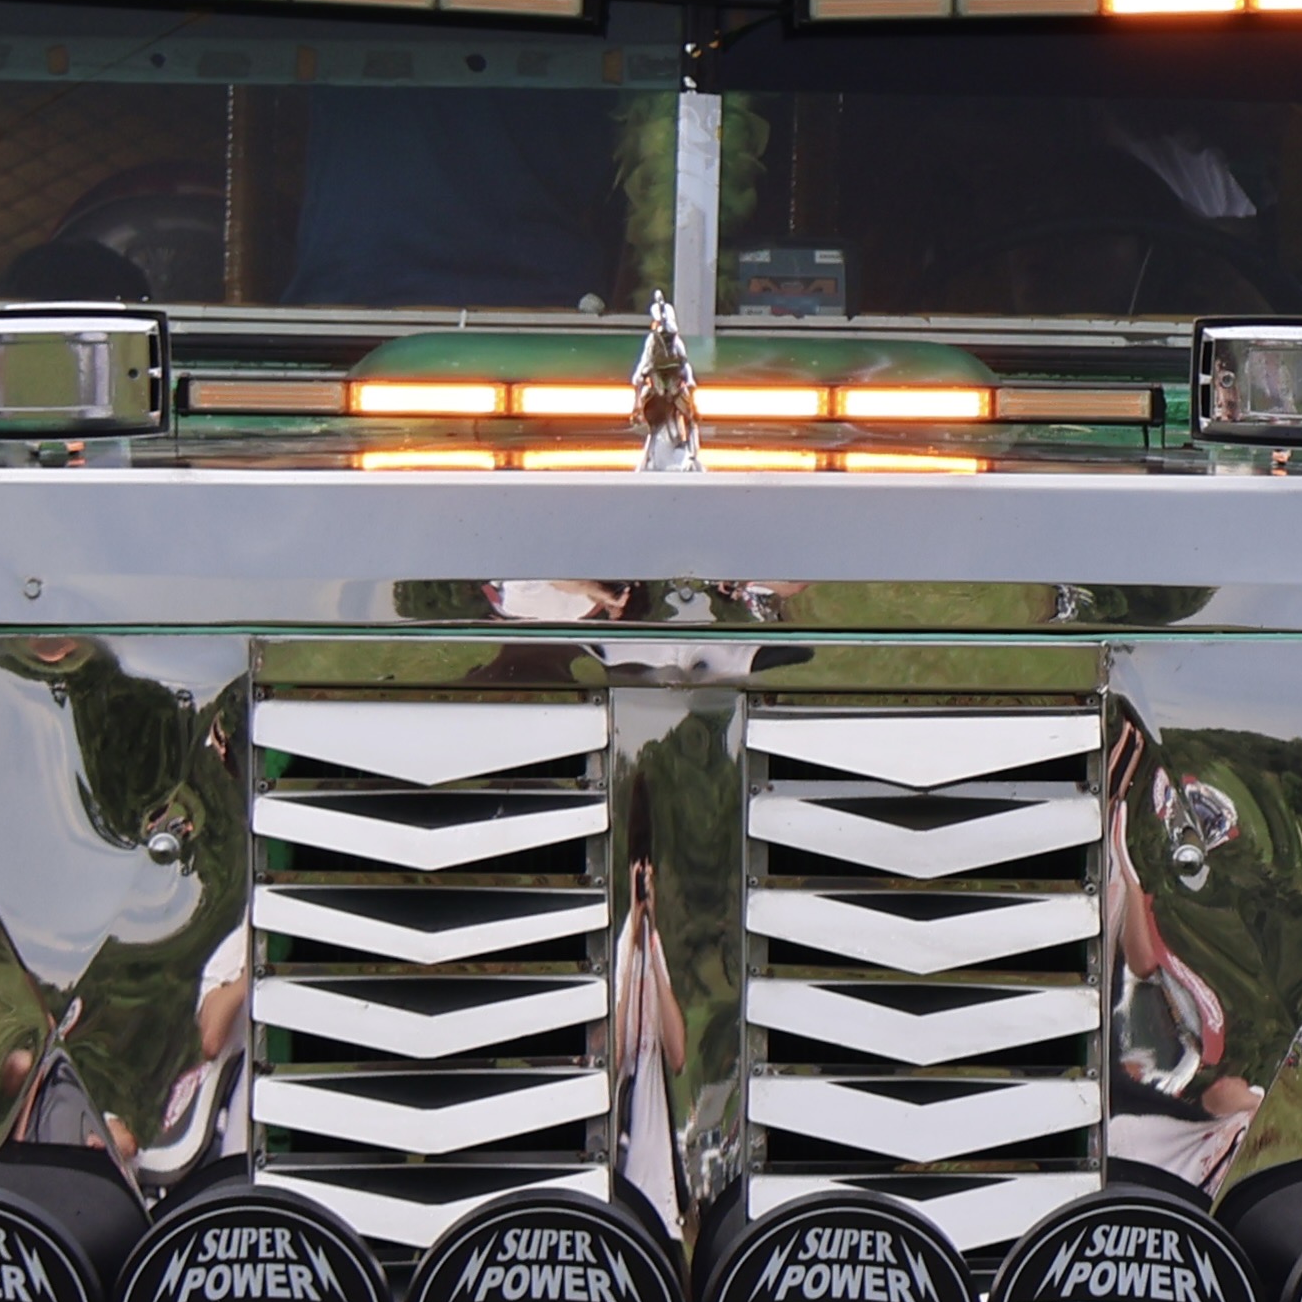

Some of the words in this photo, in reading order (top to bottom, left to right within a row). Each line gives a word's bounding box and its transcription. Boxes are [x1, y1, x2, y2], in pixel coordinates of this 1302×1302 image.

[197, 1227, 298, 1262] SUPER
[496, 1228, 597, 1263] SUPER
[797, 1227, 897, 1264] SUPER
[1084, 1224, 1184, 1263] SUPER
